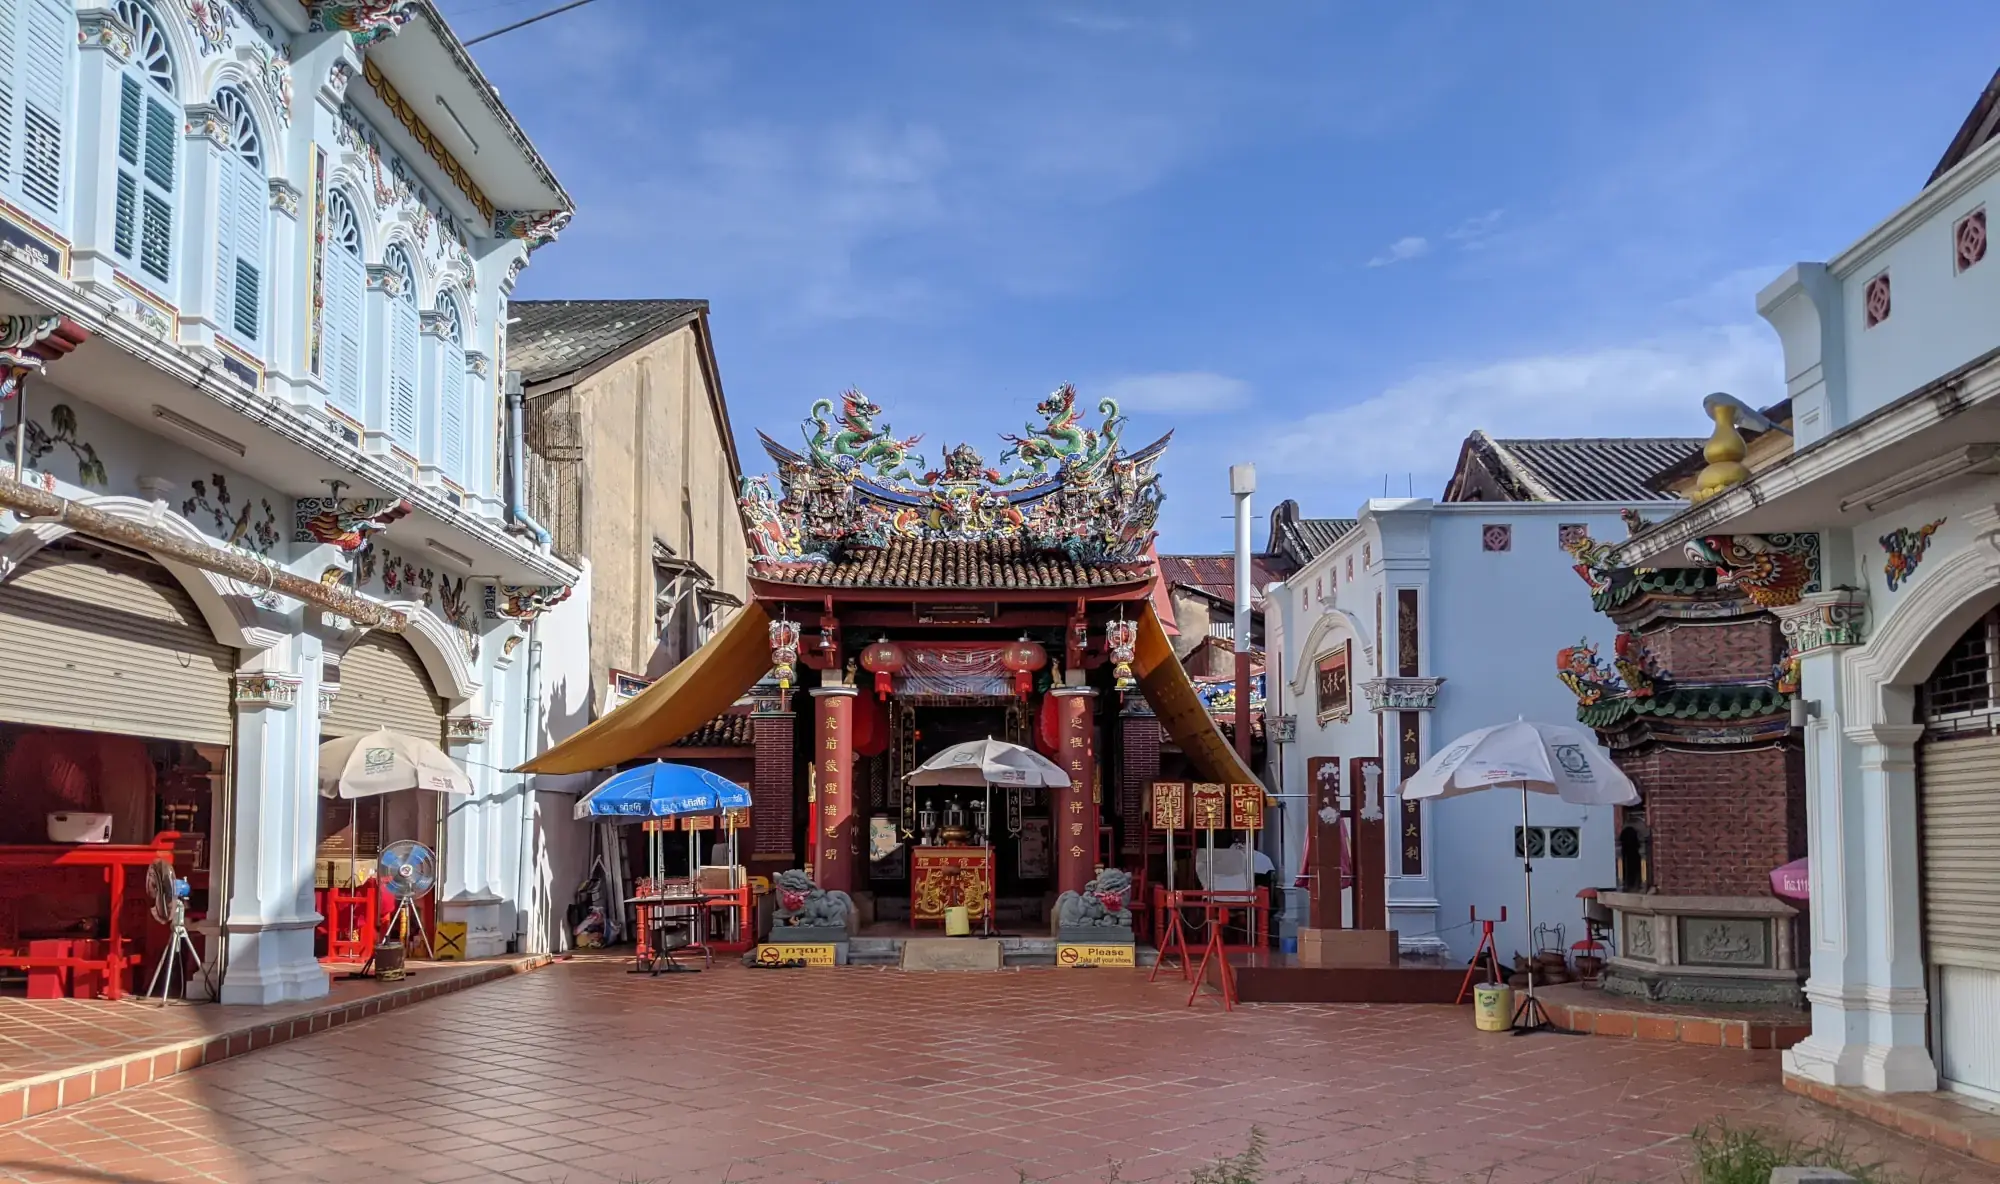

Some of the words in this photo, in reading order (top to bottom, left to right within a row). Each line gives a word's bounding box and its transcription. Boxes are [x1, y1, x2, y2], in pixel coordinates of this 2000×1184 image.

[1404, 728, 1419, 861] 大福吉大利
[1088, 948, 1124, 956] Please
